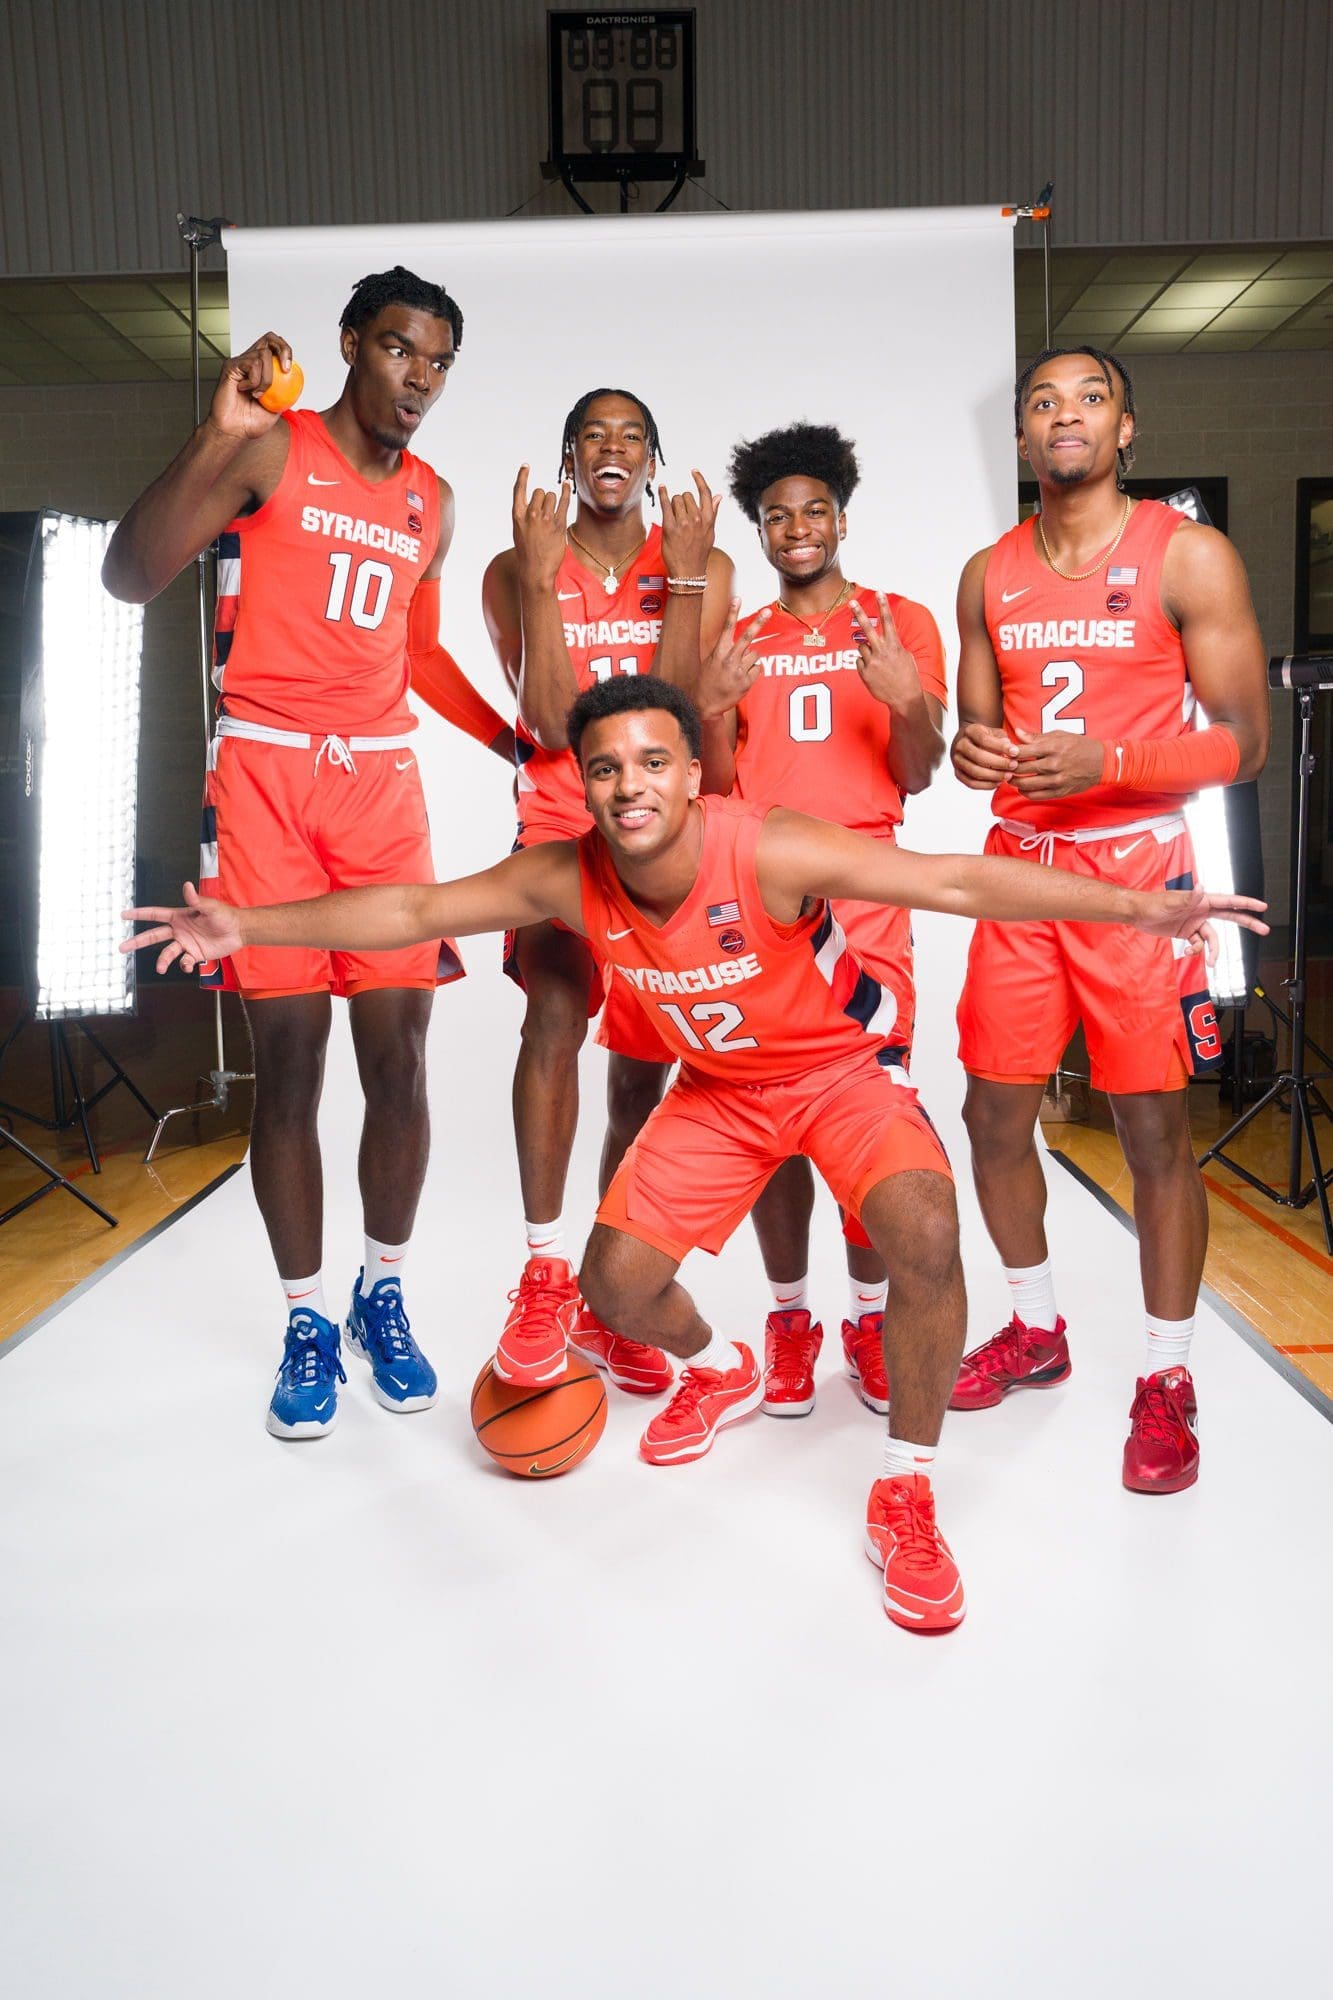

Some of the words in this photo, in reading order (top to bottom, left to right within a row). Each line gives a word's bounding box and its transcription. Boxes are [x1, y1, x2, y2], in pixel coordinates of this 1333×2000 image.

[586, 16, 656, 24] DAKTRONICS
[301, 506, 420, 562] SYRACUSE
[325, 552, 394, 631] 10
[999, 620, 1136, 650] SYRACUSE
[755, 649, 862, 676] YRACUS
[788, 681, 832, 742] 0
[1041, 660, 1085, 735] 2
[614, 953, 762, 994] SYRACUSE
[656, 1000, 760, 1053] 12
[1189, 1001, 1222, 1060] S
